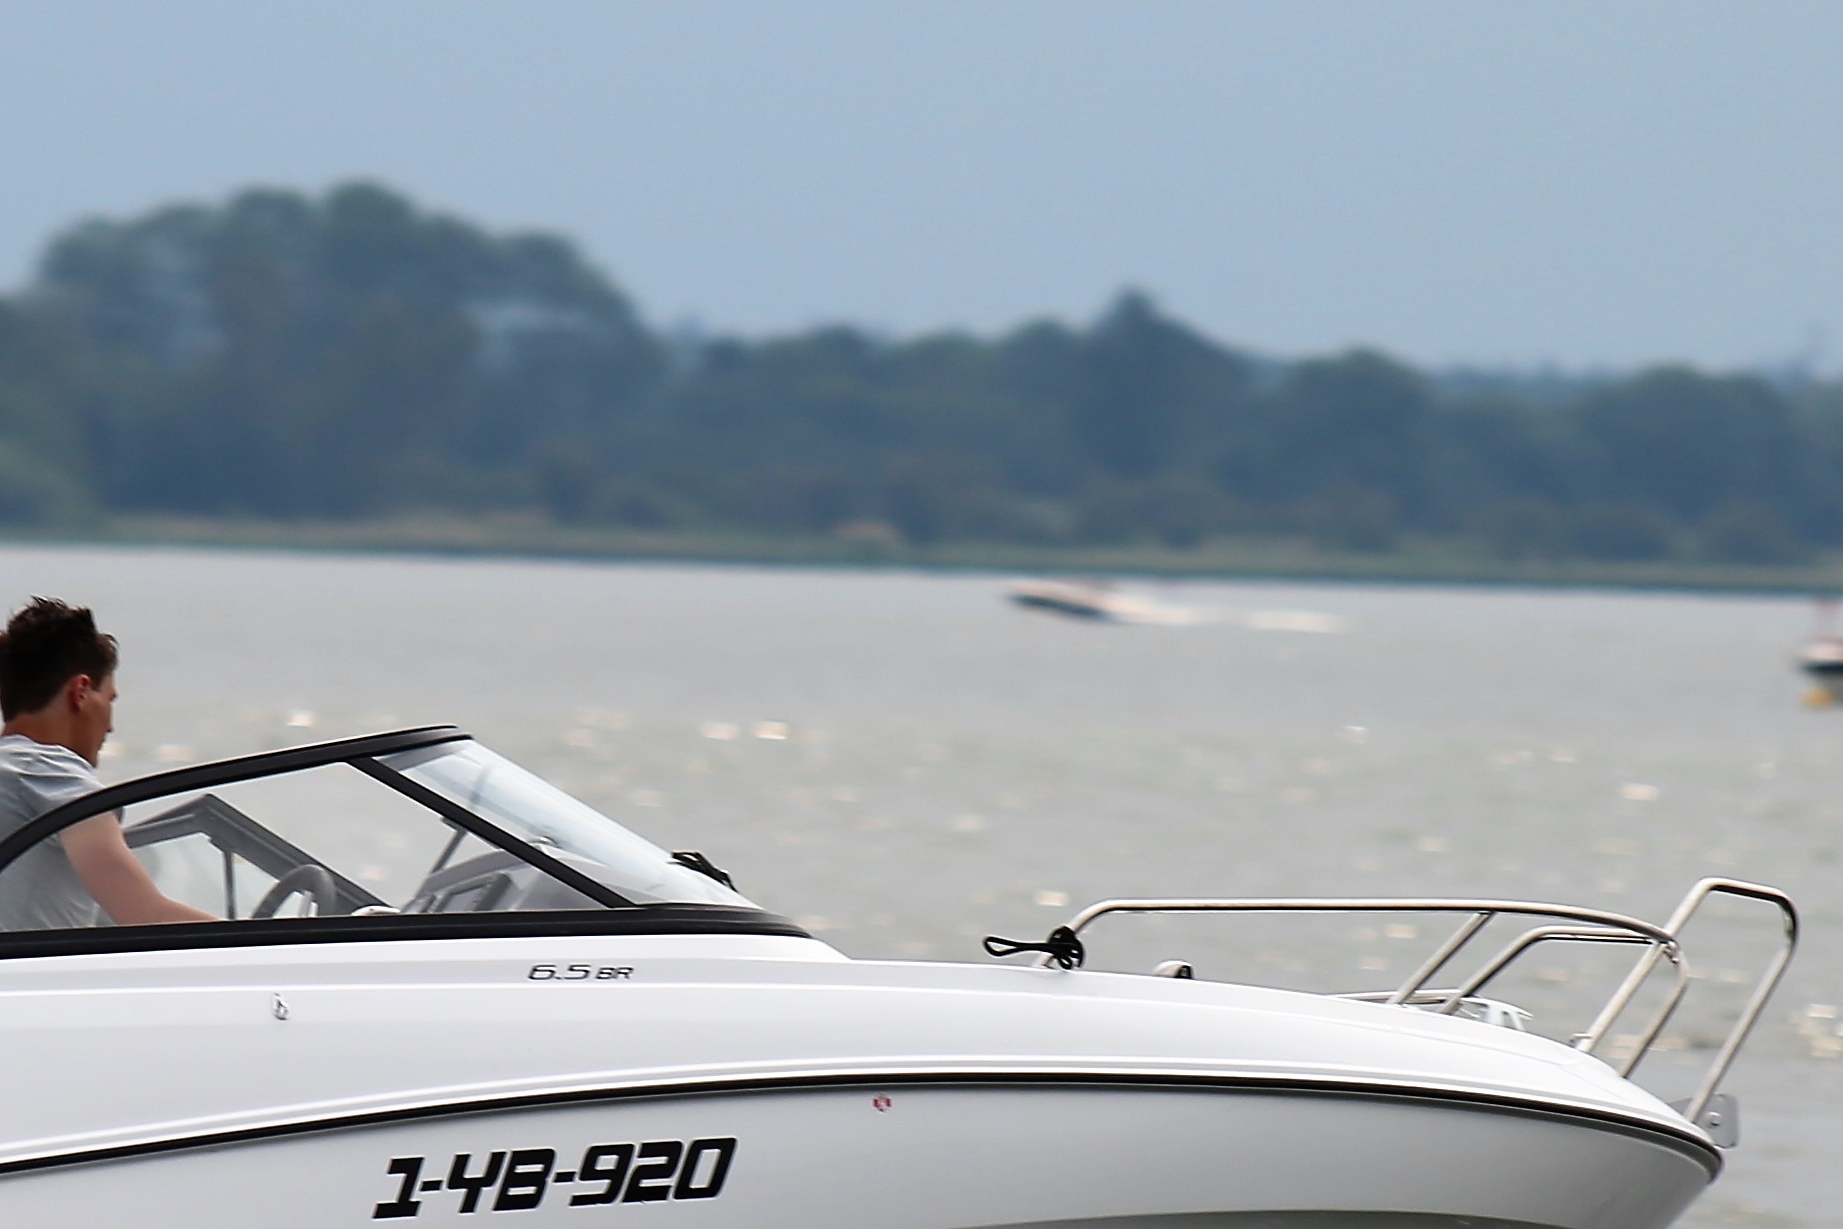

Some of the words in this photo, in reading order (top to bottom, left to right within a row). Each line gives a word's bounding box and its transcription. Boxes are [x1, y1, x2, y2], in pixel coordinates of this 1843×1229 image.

[528, 964, 591, 980] 6.5
[595, 967, 634, 980] BR
[372, 1137, 737, 1219] 1-YB-920
